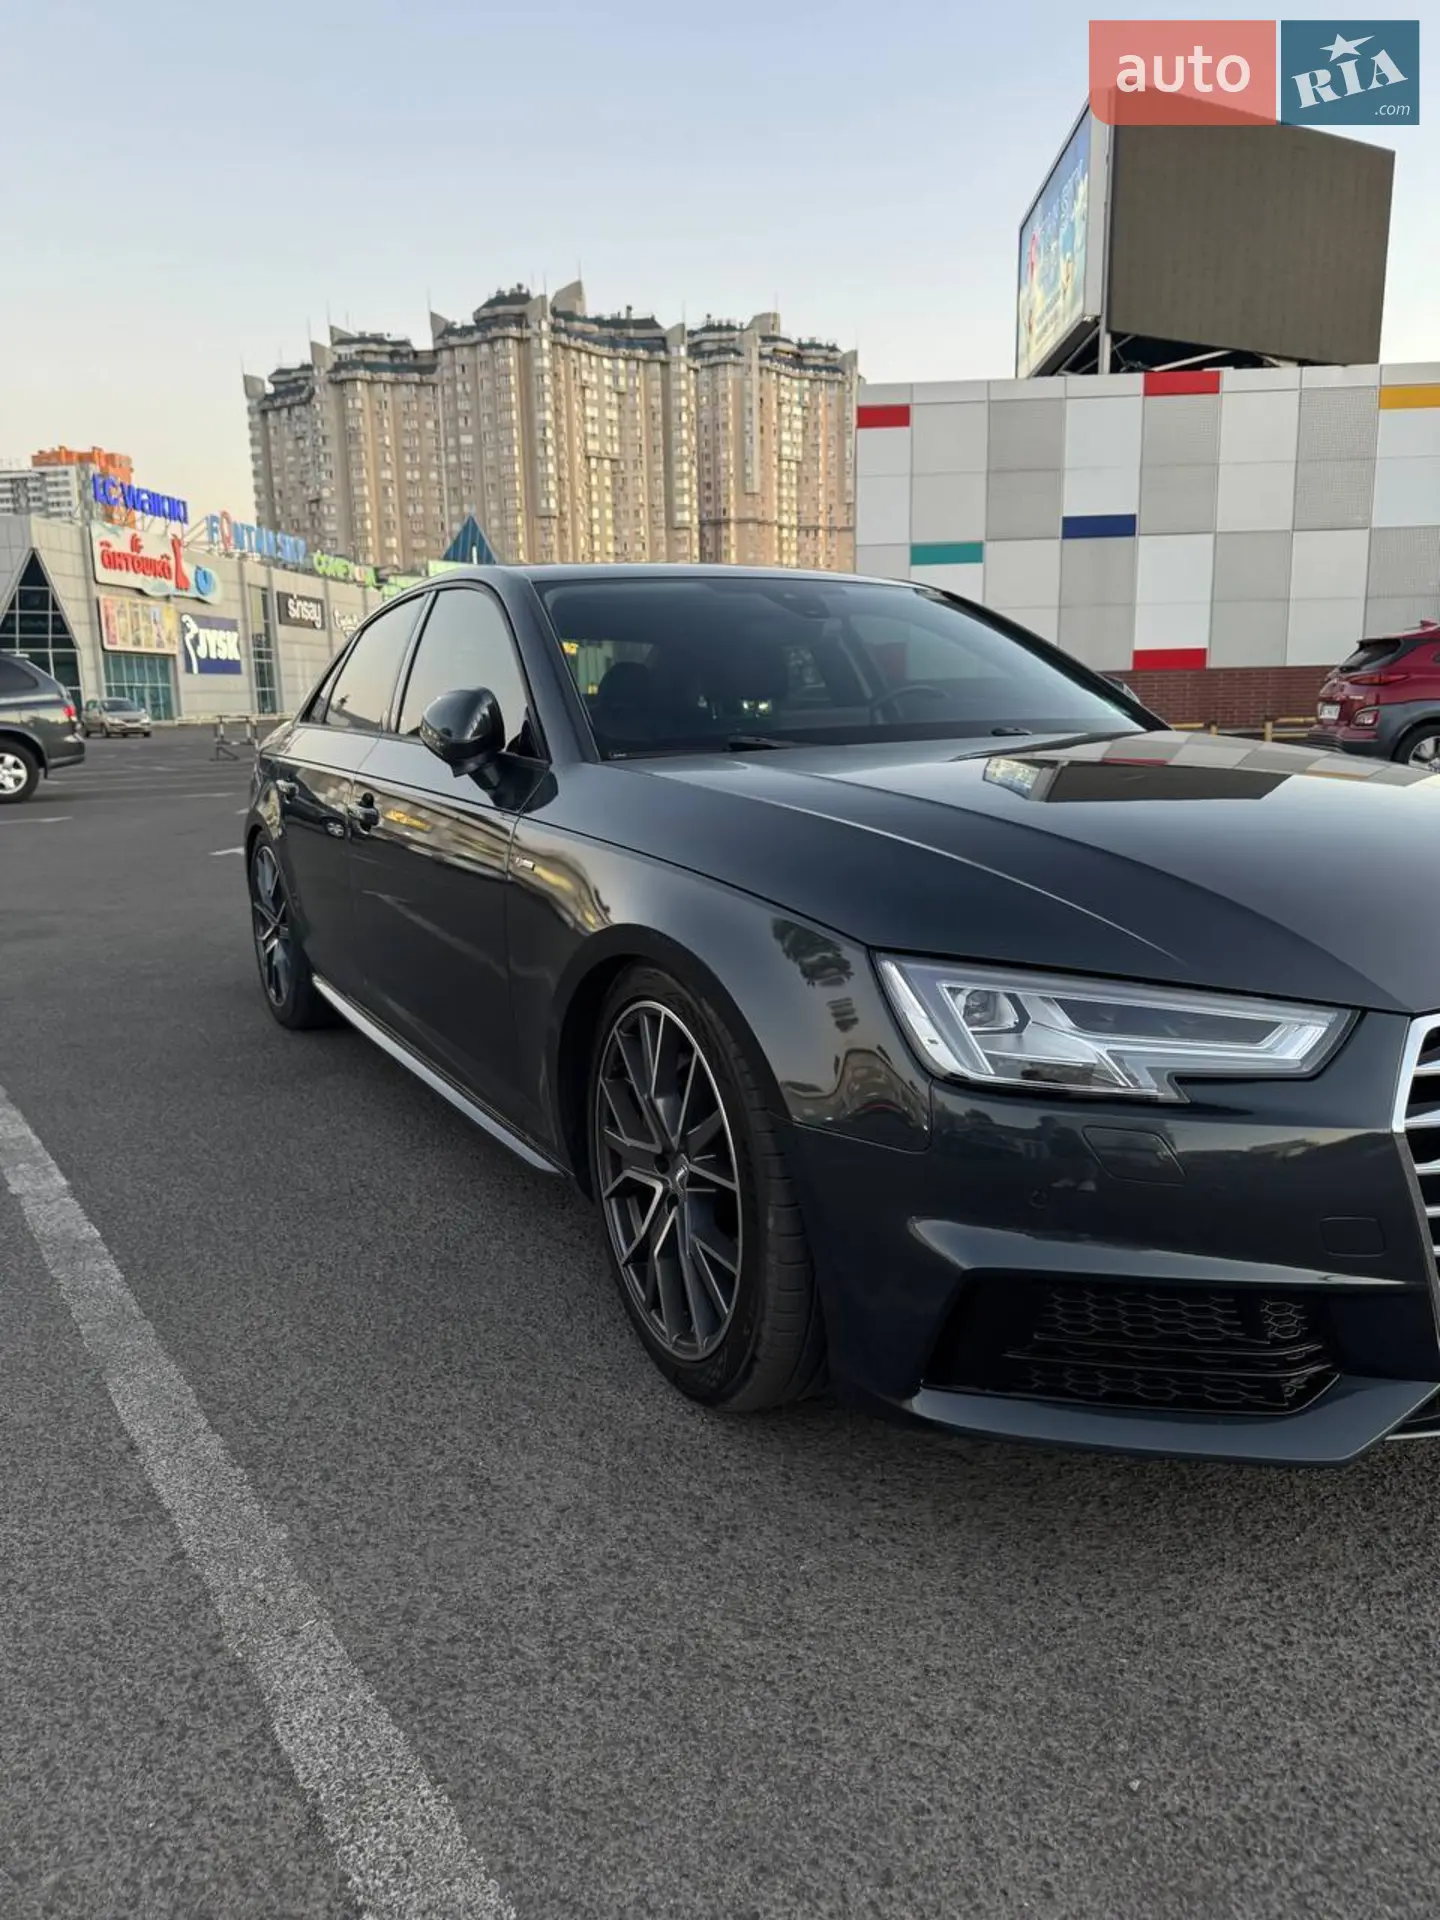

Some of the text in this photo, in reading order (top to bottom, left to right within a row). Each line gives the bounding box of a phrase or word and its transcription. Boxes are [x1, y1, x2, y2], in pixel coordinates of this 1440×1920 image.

[93, 473, 120, 506] LC
[288, 594, 322, 629] sinsay
[197, 628, 241, 661] JYSK
